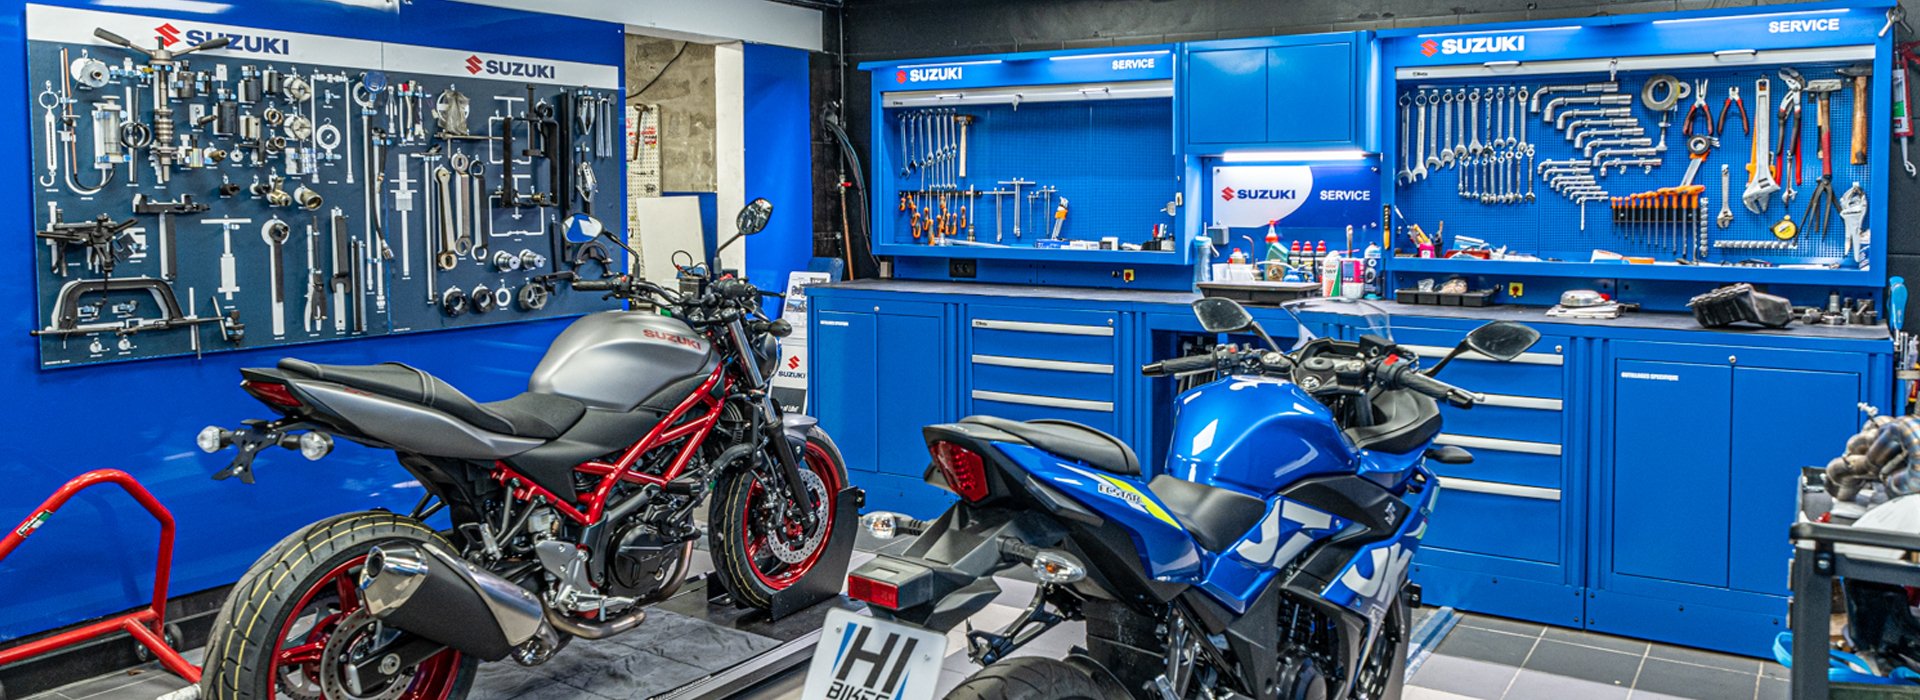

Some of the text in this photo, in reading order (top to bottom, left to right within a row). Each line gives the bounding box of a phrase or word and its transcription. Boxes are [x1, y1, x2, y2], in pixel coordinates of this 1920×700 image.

[1768, 18, 1840, 33] SERVICE
[1441, 35, 1525, 55] SUZUKI
[486, 60, 555, 79] SUZUKI
[1112, 58, 1155, 70] SERVICE
[909, 66, 963, 82] SUZUKI
[1237, 189, 1371, 201] SUZUKI SERVICE
[643, 328, 702, 350] SUZUKI
[778, 371, 806, 379] SUZUKI
[835, 625, 919, 694] HI
